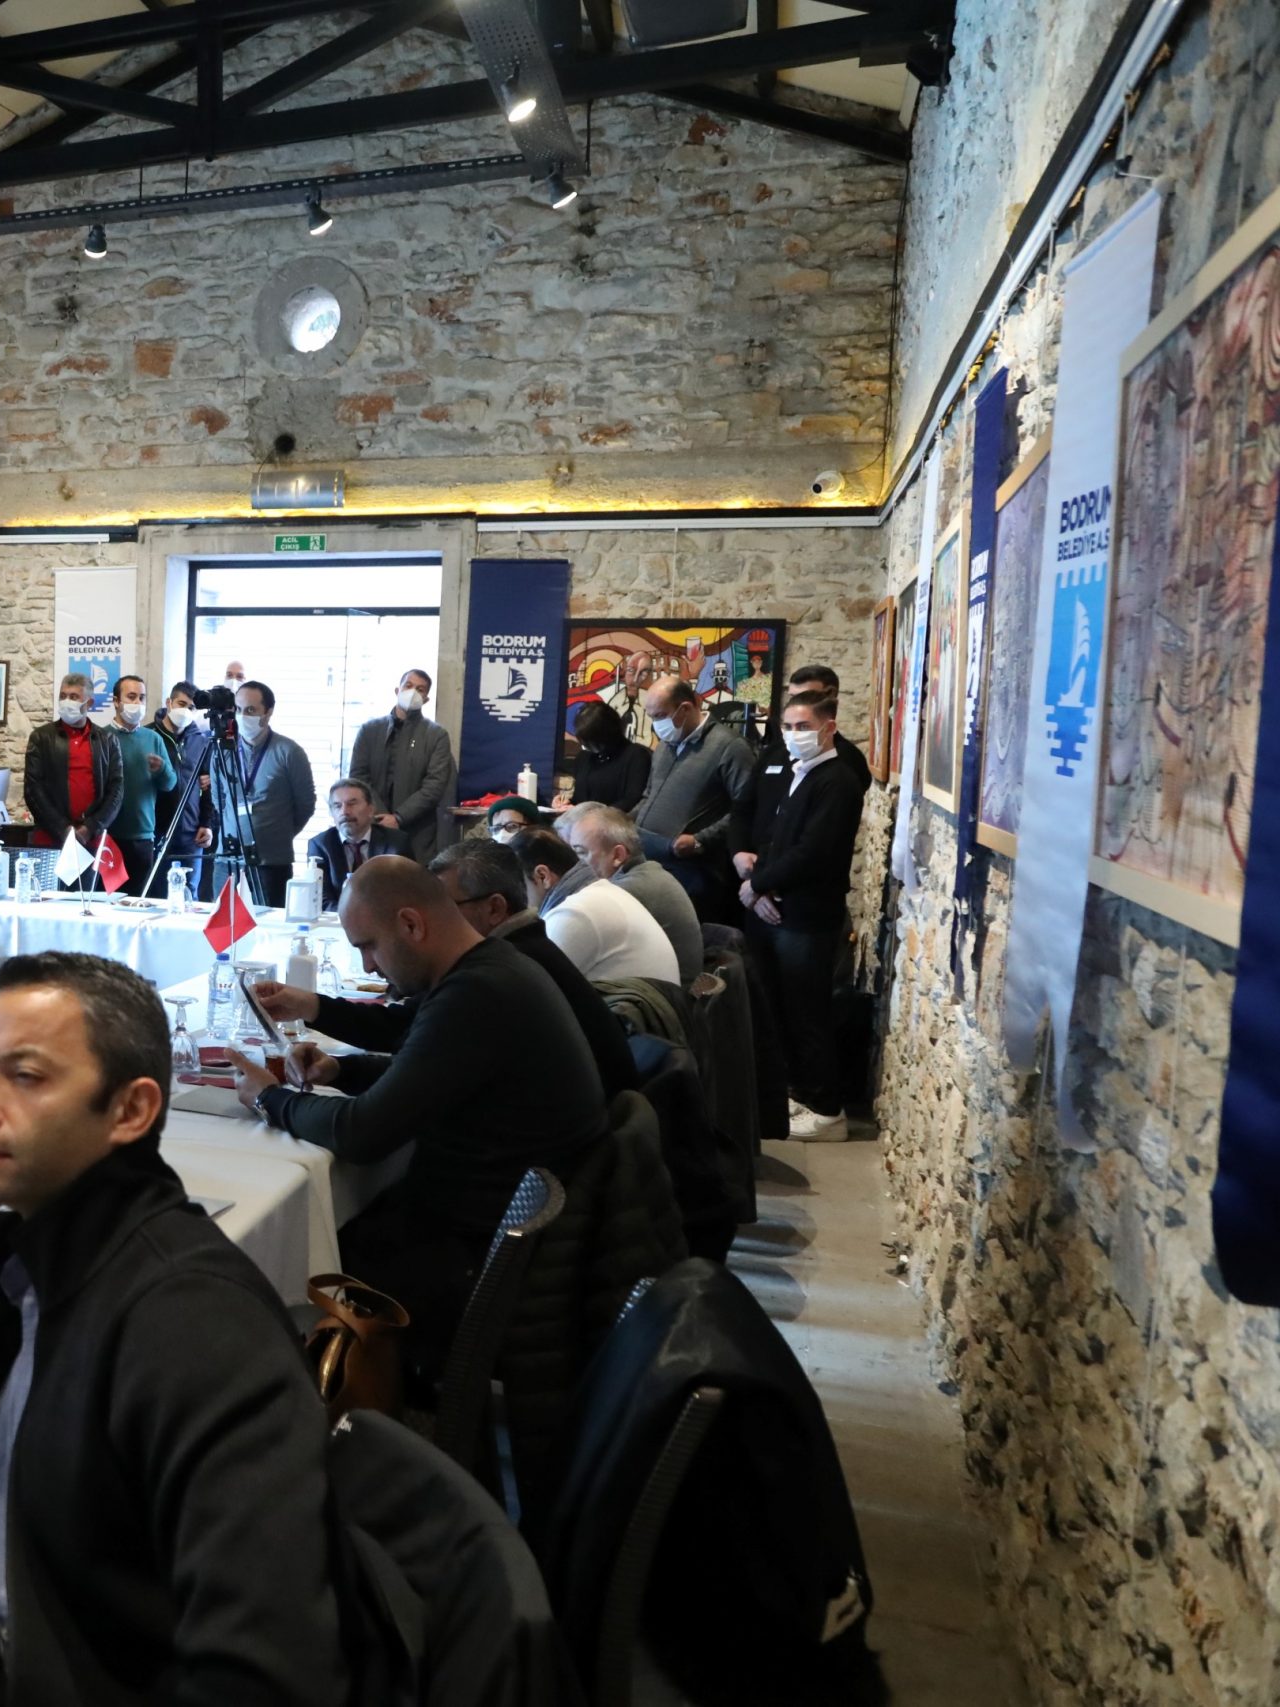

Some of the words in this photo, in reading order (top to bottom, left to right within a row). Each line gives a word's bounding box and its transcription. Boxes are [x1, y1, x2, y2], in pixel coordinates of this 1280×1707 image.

[68, 635, 122, 646] BODRUM
[482, 634, 546, 648] BODRUM
[68, 646, 106, 654] BELEDİYE
[481, 646, 527, 656] BELEDİYE
